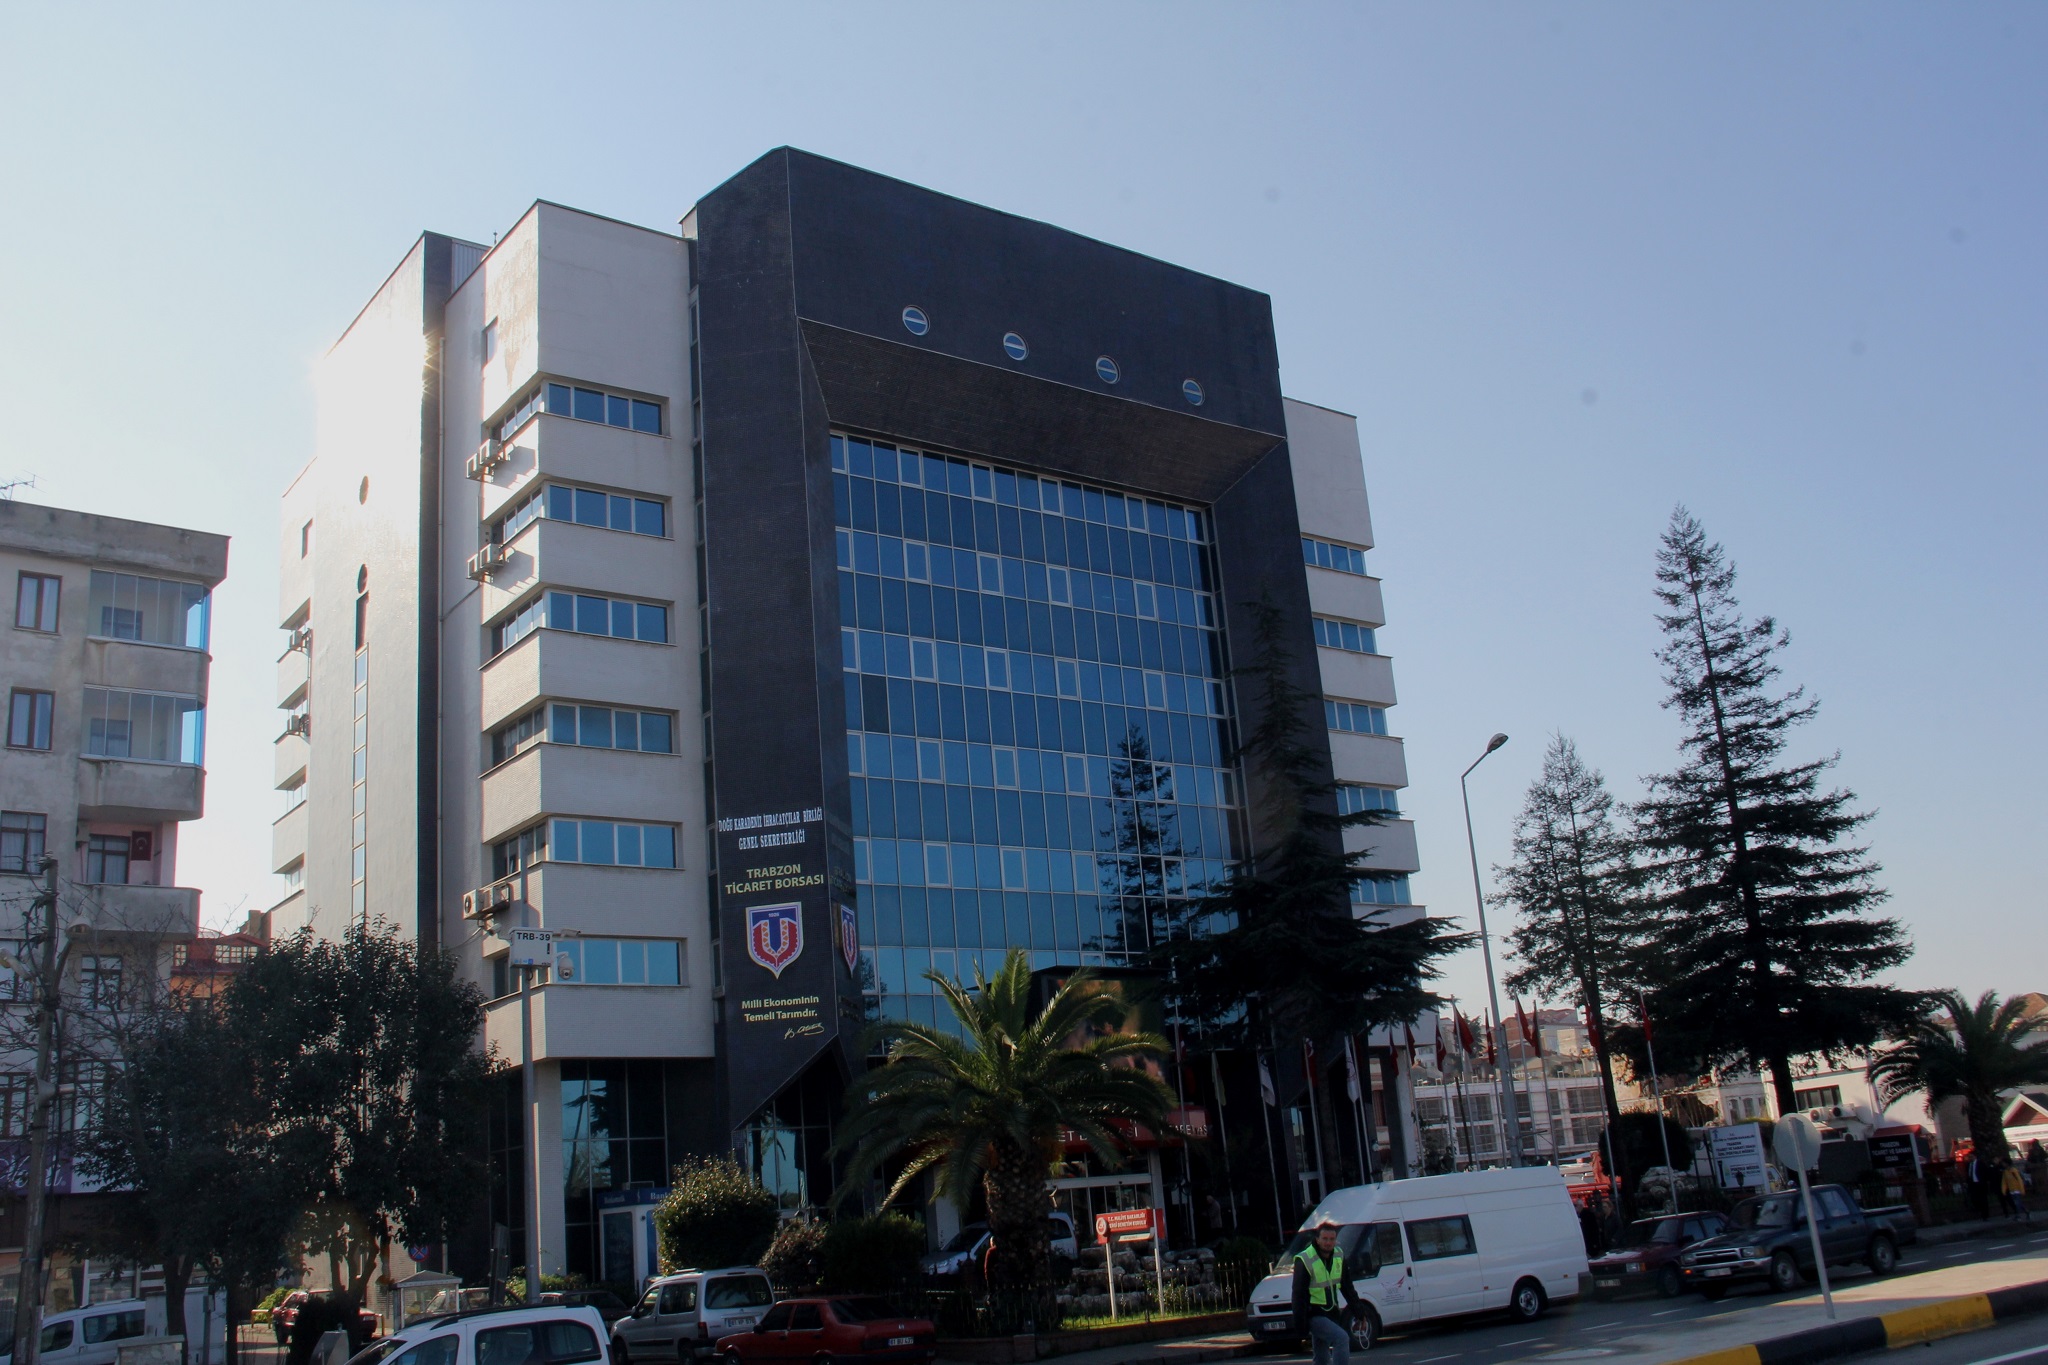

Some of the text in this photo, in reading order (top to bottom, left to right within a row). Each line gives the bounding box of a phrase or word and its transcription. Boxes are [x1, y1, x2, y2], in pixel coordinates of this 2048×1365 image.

[738, 836, 758, 850] GENEL
[746, 864, 801, 879] TRABZON
[725, 878, 772, 895] TİCARET
[774, 874, 824, 890] BORSASI
[516, 932, 550, 941] TRB-39
[764, 995, 819, 1008] Ekonominin
[744, 1008, 818, 1022] Temeli Tarımdır.
